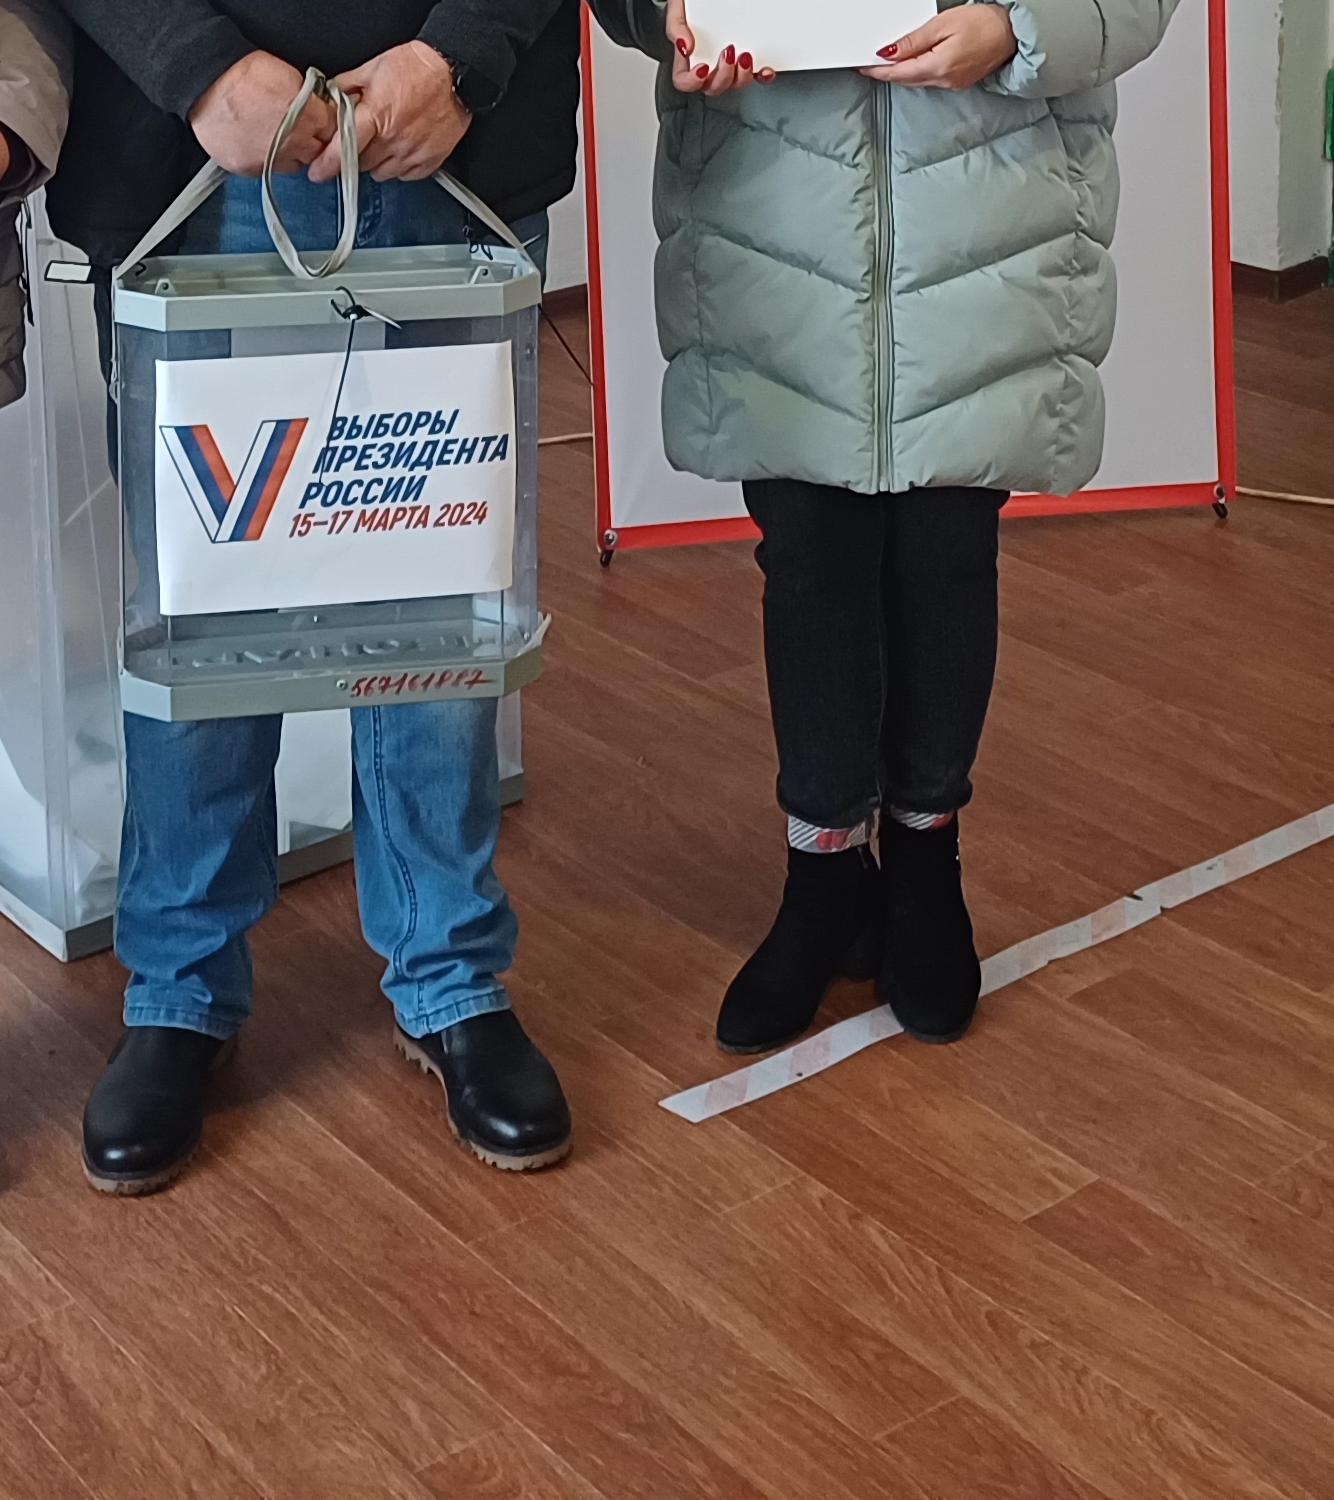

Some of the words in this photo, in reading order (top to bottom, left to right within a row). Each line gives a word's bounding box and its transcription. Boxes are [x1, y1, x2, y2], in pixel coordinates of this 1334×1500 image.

[329, 408, 461, 442] ВЫБОРЫ
[311, 432, 510, 475] ПРЕЗИДЕНТА
[298, 474, 429, 510] РОССИИ
[353, 504, 431, 534] МАРТА
[433, 500, 489, 528] 2024
